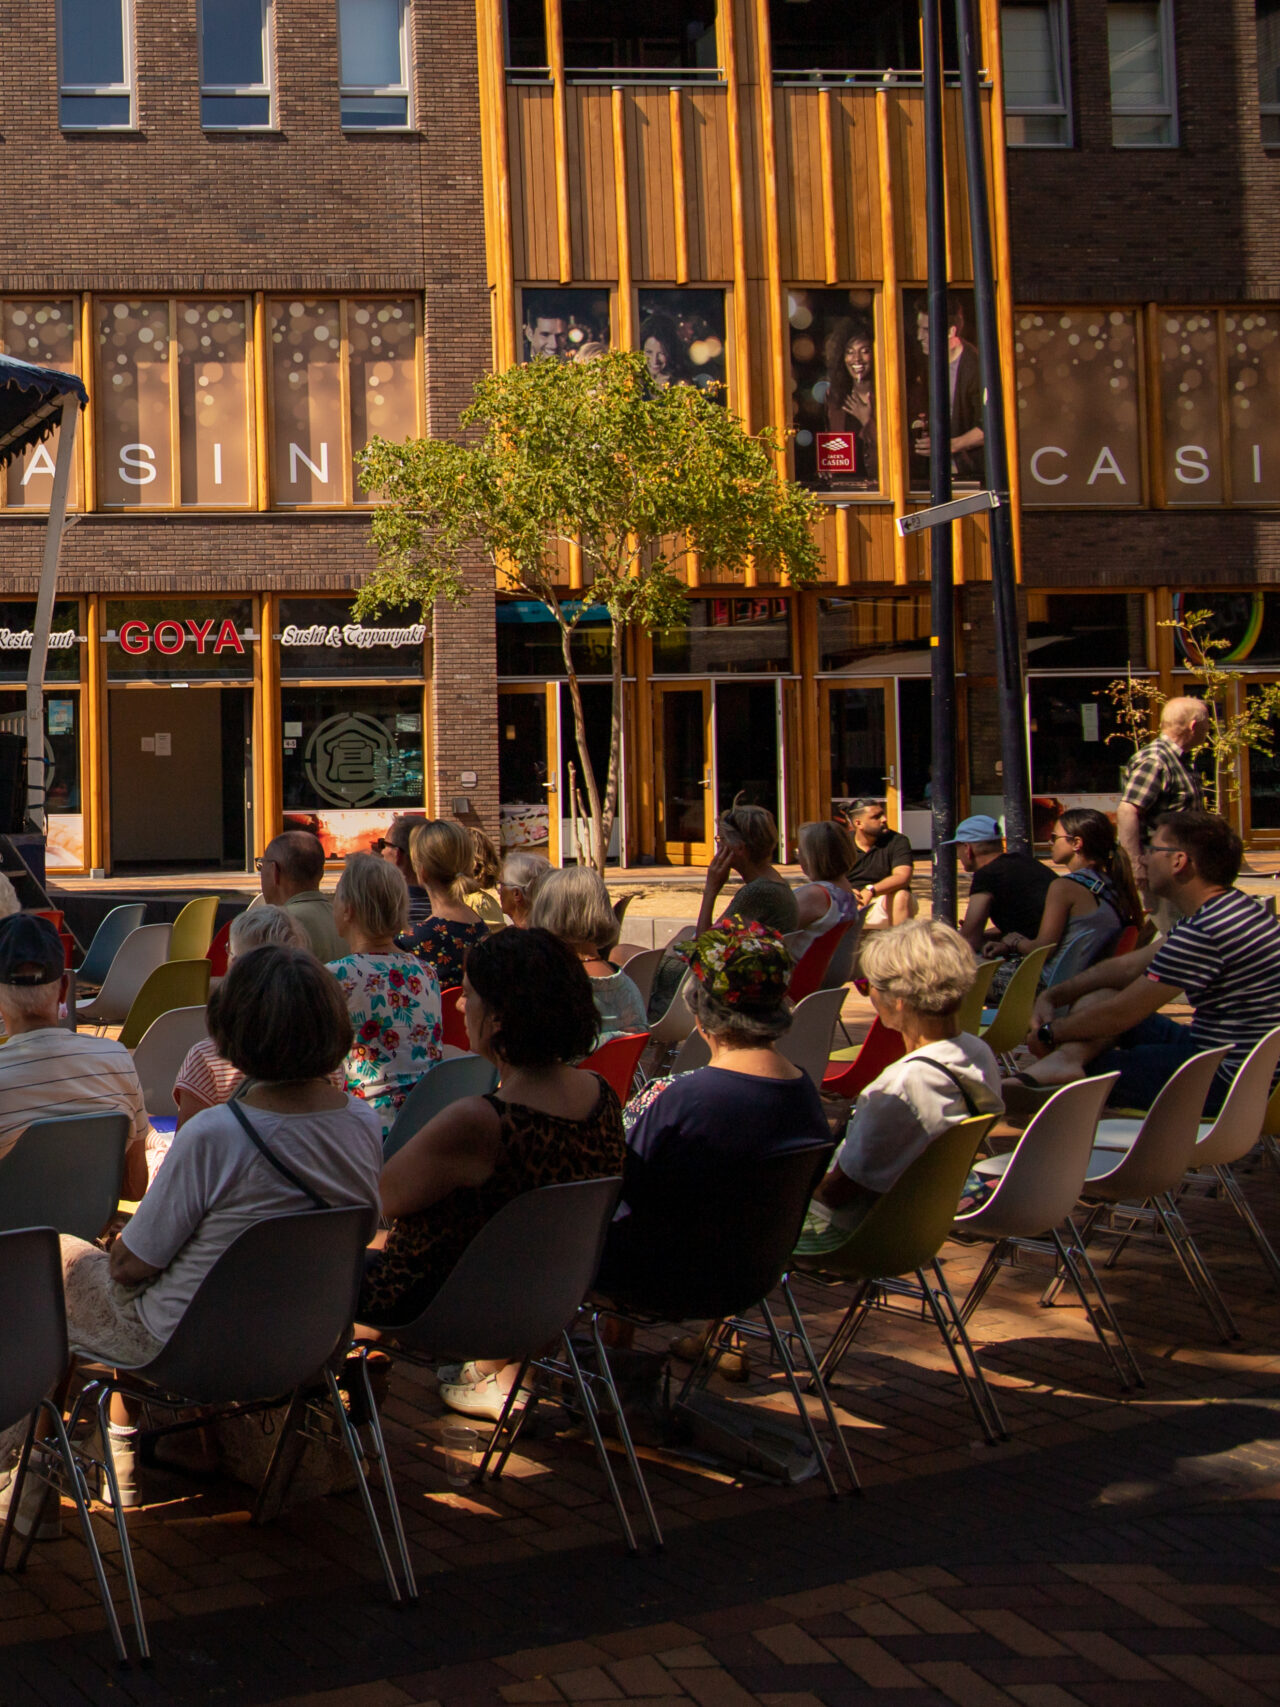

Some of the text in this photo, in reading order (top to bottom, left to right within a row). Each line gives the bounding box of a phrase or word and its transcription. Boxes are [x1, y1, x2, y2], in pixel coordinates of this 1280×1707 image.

[822, 458, 850, 466] CASINO
[1030, 444, 1262, 486] CASI
[120, 619, 246, 655] GOYA
[281, 624, 426, 648] Sushi & Teppanyaki
